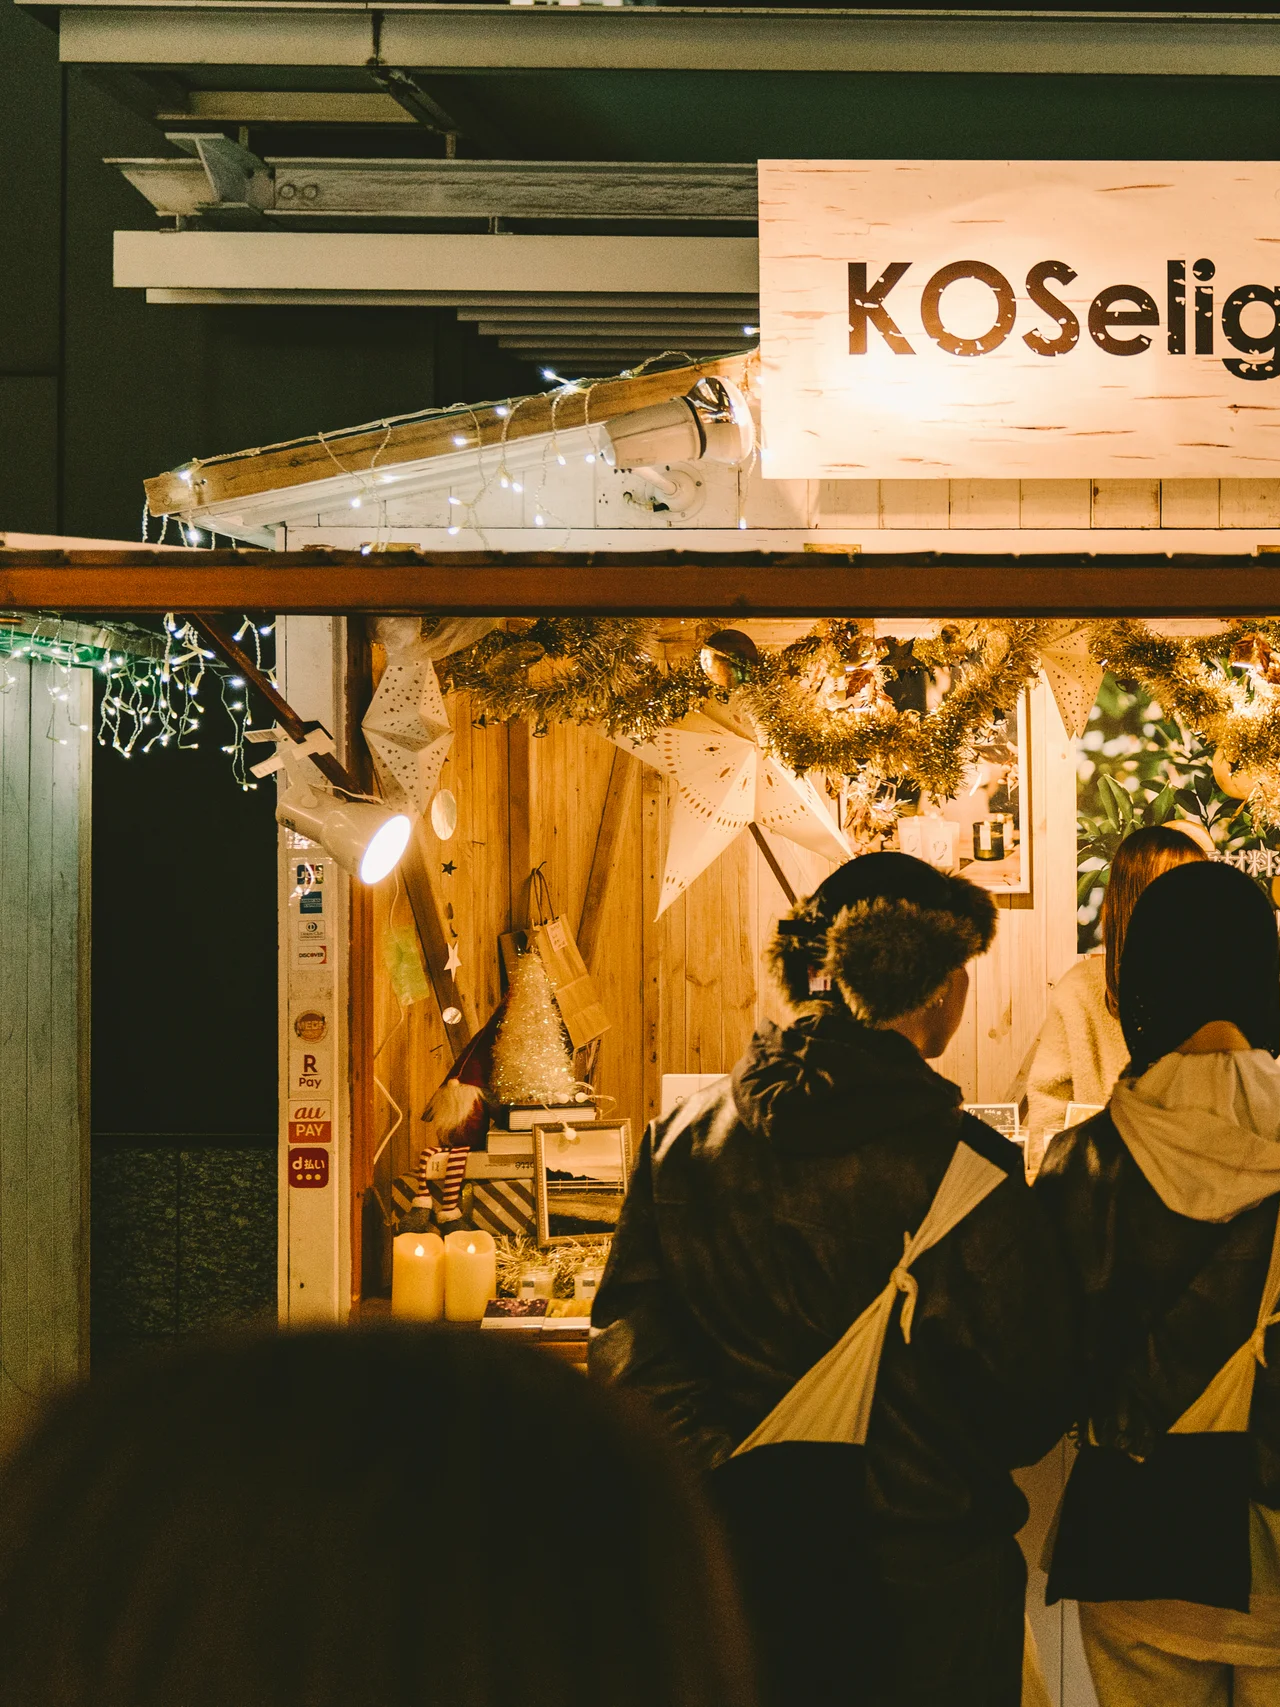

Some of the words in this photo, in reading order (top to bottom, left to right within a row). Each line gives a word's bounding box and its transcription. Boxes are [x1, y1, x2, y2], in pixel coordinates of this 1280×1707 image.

[304, 1054, 318, 1073] R
[299, 1077, 322, 1089] Pay
[294, 1107, 326, 1119] au
[296, 1123, 324, 1137] PAY
[292, 1156, 325, 1170] d払い
